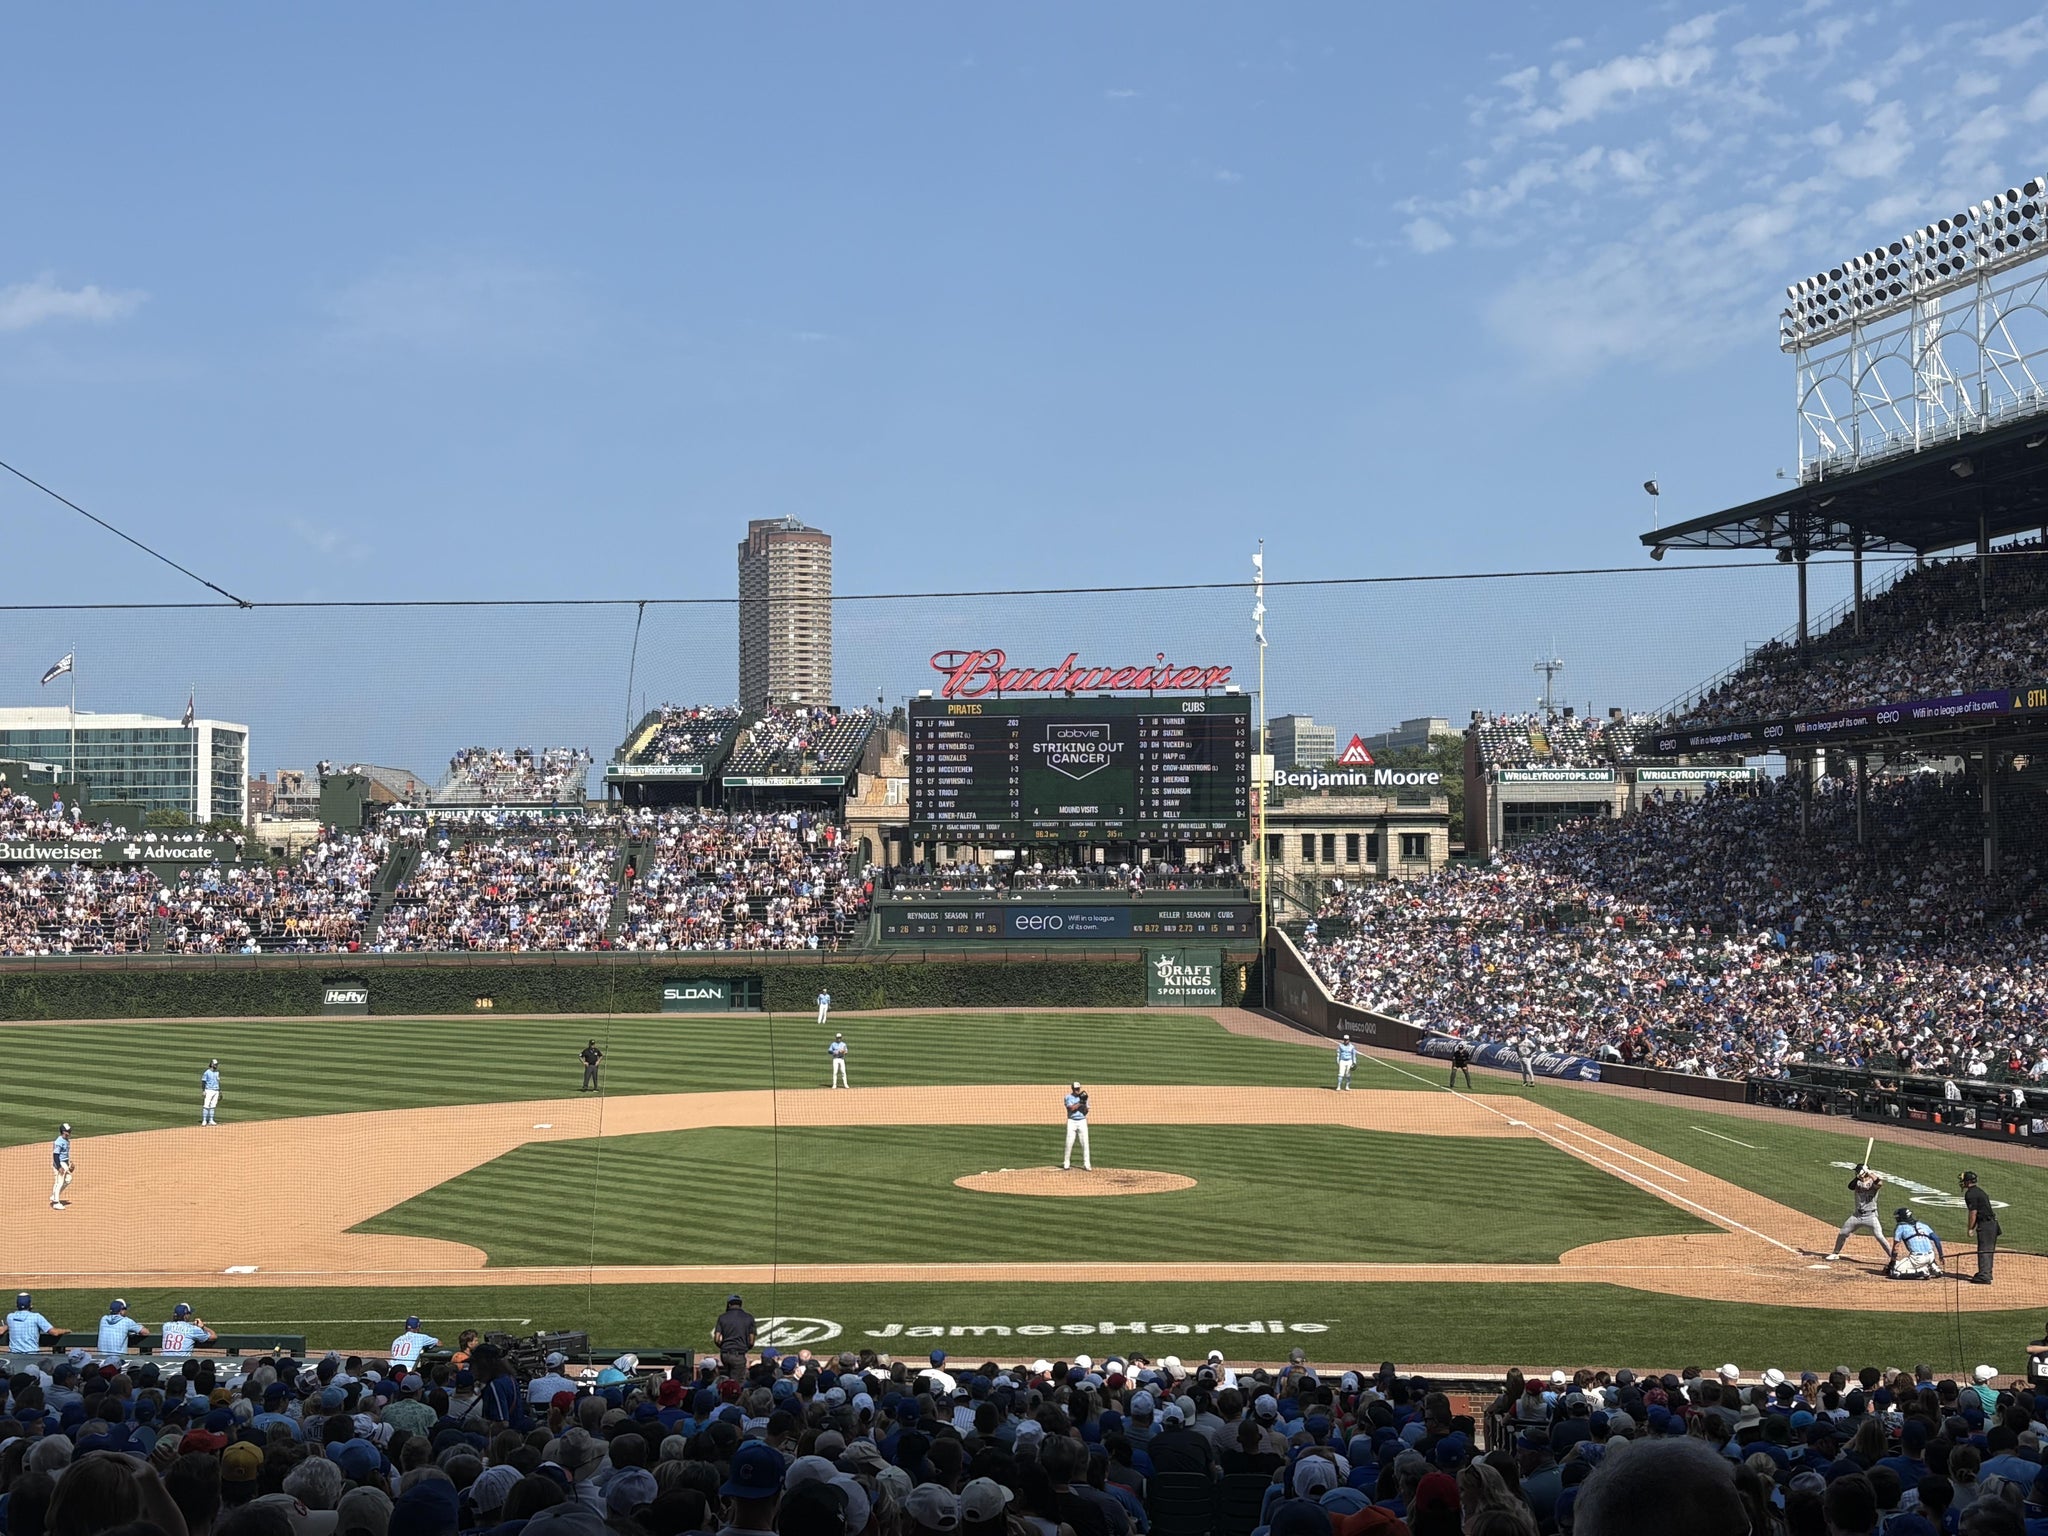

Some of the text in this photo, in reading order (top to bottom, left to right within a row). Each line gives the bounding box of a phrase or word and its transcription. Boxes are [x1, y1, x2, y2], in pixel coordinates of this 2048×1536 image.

[930, 648, 1233, 697] Budweiser
[2027, 689, 2048, 708] 8TH
[948, 704, 982, 714] PIRATES
[1182, 702, 1205, 712] CUBS
[1927, 707, 1933, 717] in
[1940, 704, 1963, 718] league
[1964, 702, 1972, 713] of
[1972, 701, 1981, 712] its
[1981, 701, 1999, 710] own.
[1876, 710, 1900, 725] eero
[1057, 729, 1100, 738] abbvie
[1763, 725, 1784, 738] eero
[1032, 742, 1124, 753] STRIKING OUT
[1052, 754, 1104, 763] CANCER
[1274, 769, 1439, 790] Benjamin Moore
[1504, 771, 1609, 781] WRIGLEYROOFTOPS.COM
[1642, 770, 1750, 780] WRIGLEYROOFTOPS.COM
[1080, 806, 1099, 814] VISITS
[0, 843, 212, 860] Budweiser Advocate
[907, 912, 939, 920] REYNOLDS
[1159, 911, 1180, 919] KELLER
[1015, 915, 1063, 930] eero
[1157, 965, 1213, 978] DRAFT
[1164, 976, 1211, 986] KINGS
[327, 991, 366, 1003] Hefty
[1344, 1019, 1365, 1032] Invesco
[1532, 1051, 1562, 1072] Wrap
[864, 1321, 1330, 1338] JamesHardie
[164, 1334, 184, 1351] 68
